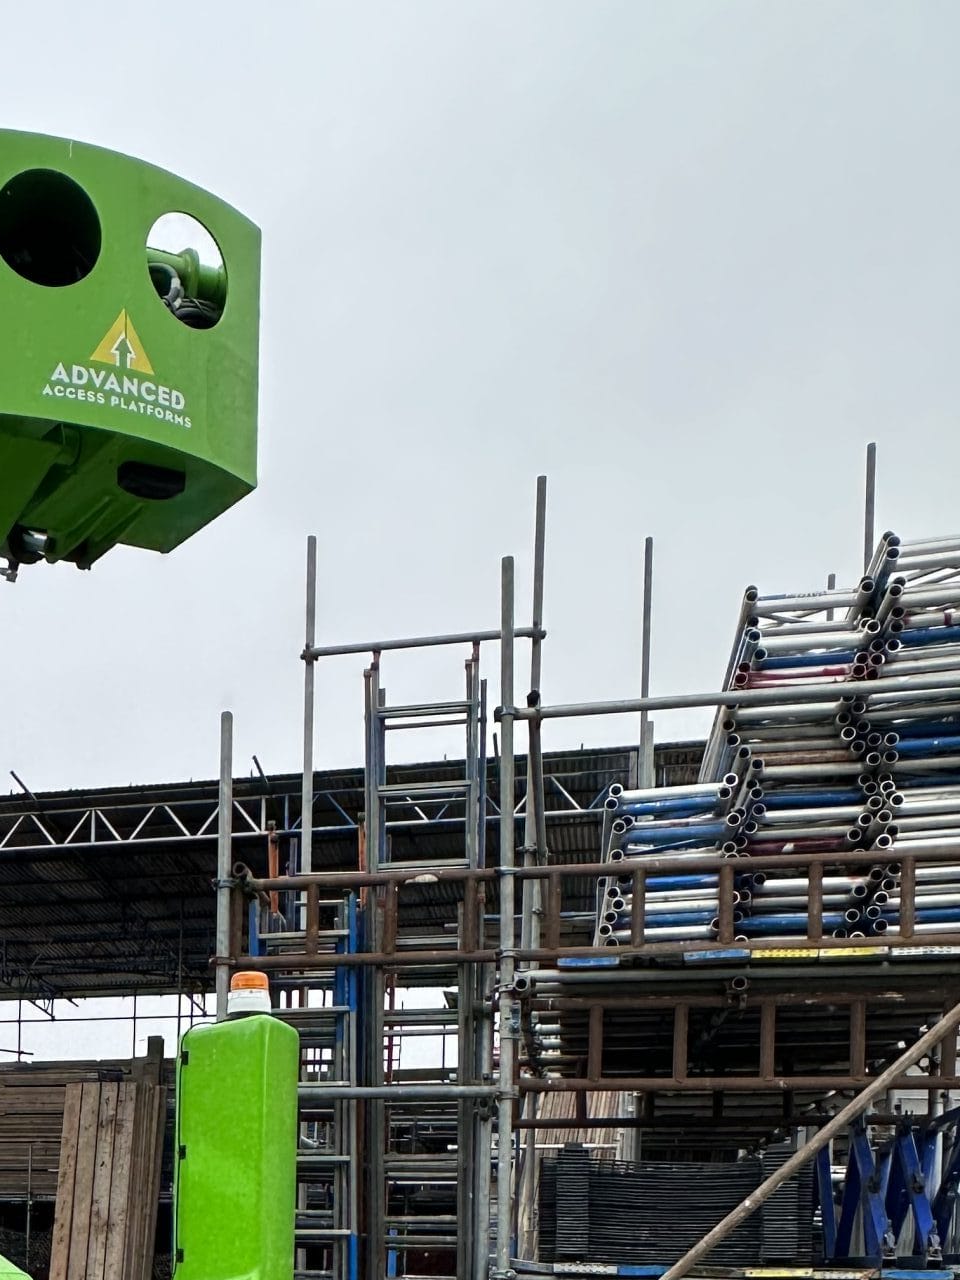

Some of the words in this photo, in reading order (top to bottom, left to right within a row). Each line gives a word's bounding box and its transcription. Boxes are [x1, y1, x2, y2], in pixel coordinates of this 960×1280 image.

[43, 384, 105, 404] ACCESS
[111, 395, 192, 429] PLATFORMS
[51, 362, 186, 410] ADVANCED
